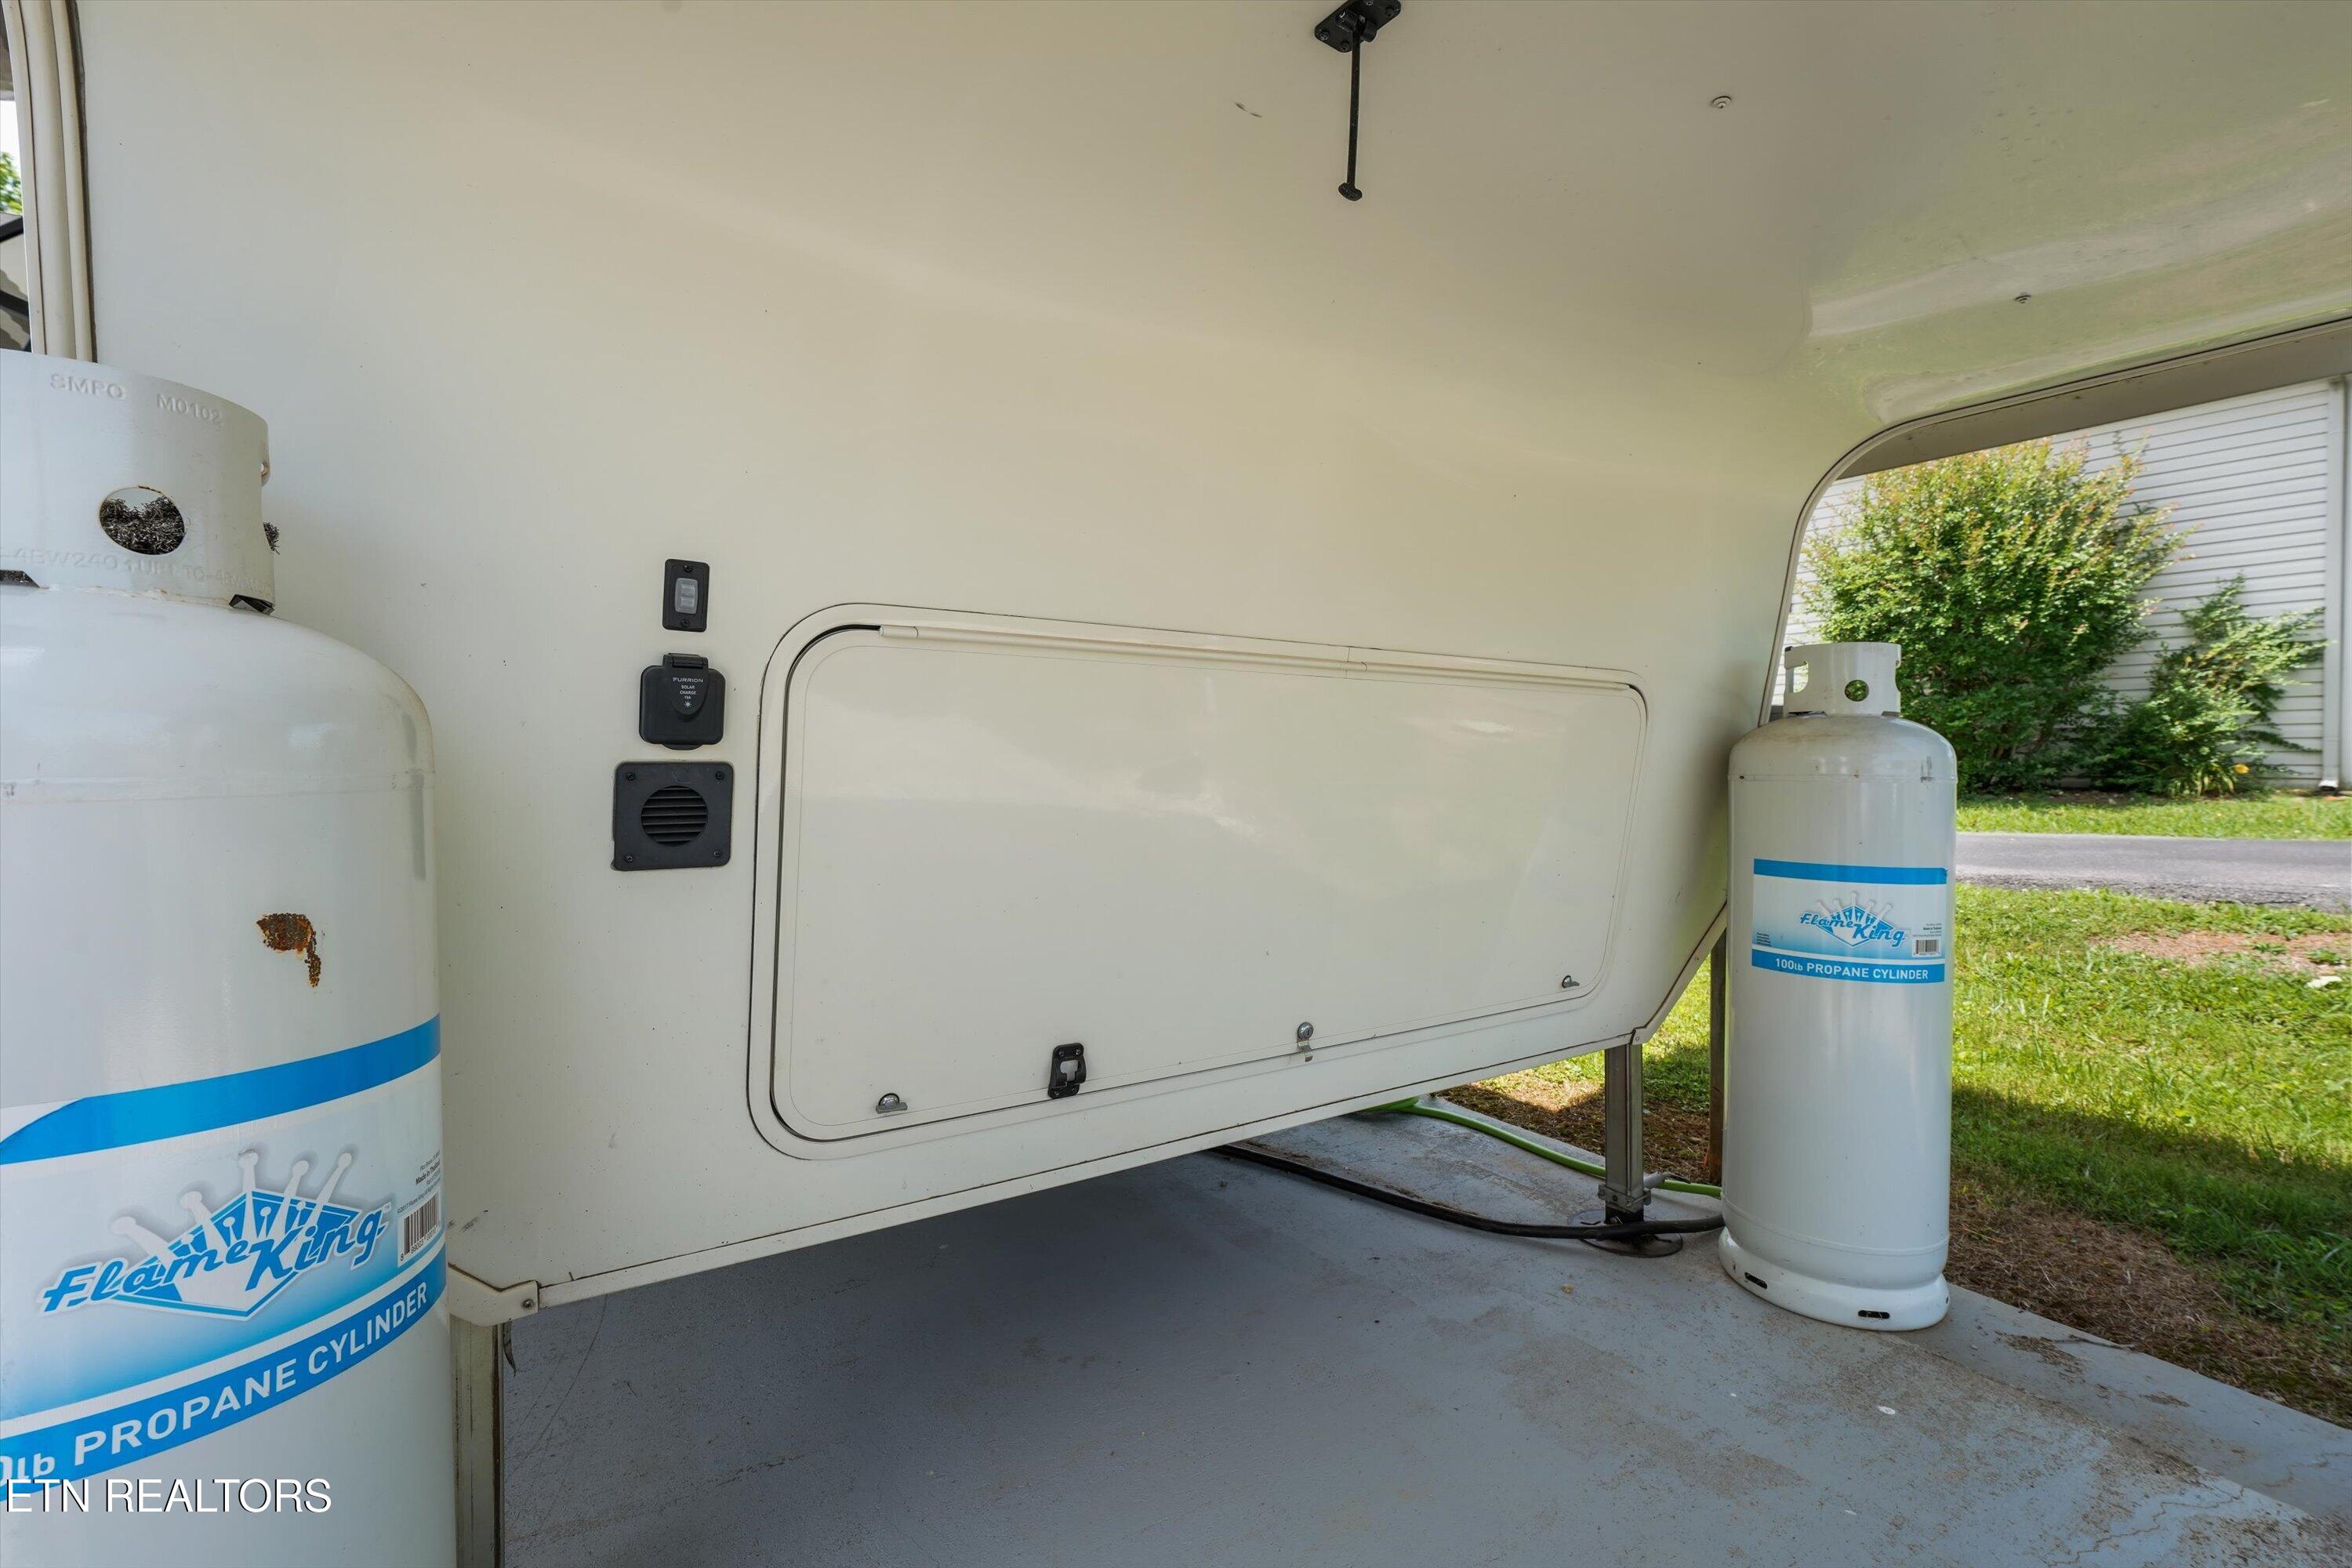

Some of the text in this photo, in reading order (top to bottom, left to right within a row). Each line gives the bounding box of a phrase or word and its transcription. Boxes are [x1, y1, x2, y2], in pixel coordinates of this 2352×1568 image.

[1775, 957, 1929, 980] 100lb PROPANE CYLINDER
[74, 1359, 296, 1466] PROPANE
[307, 1281, 428, 1376] CYLINDER
